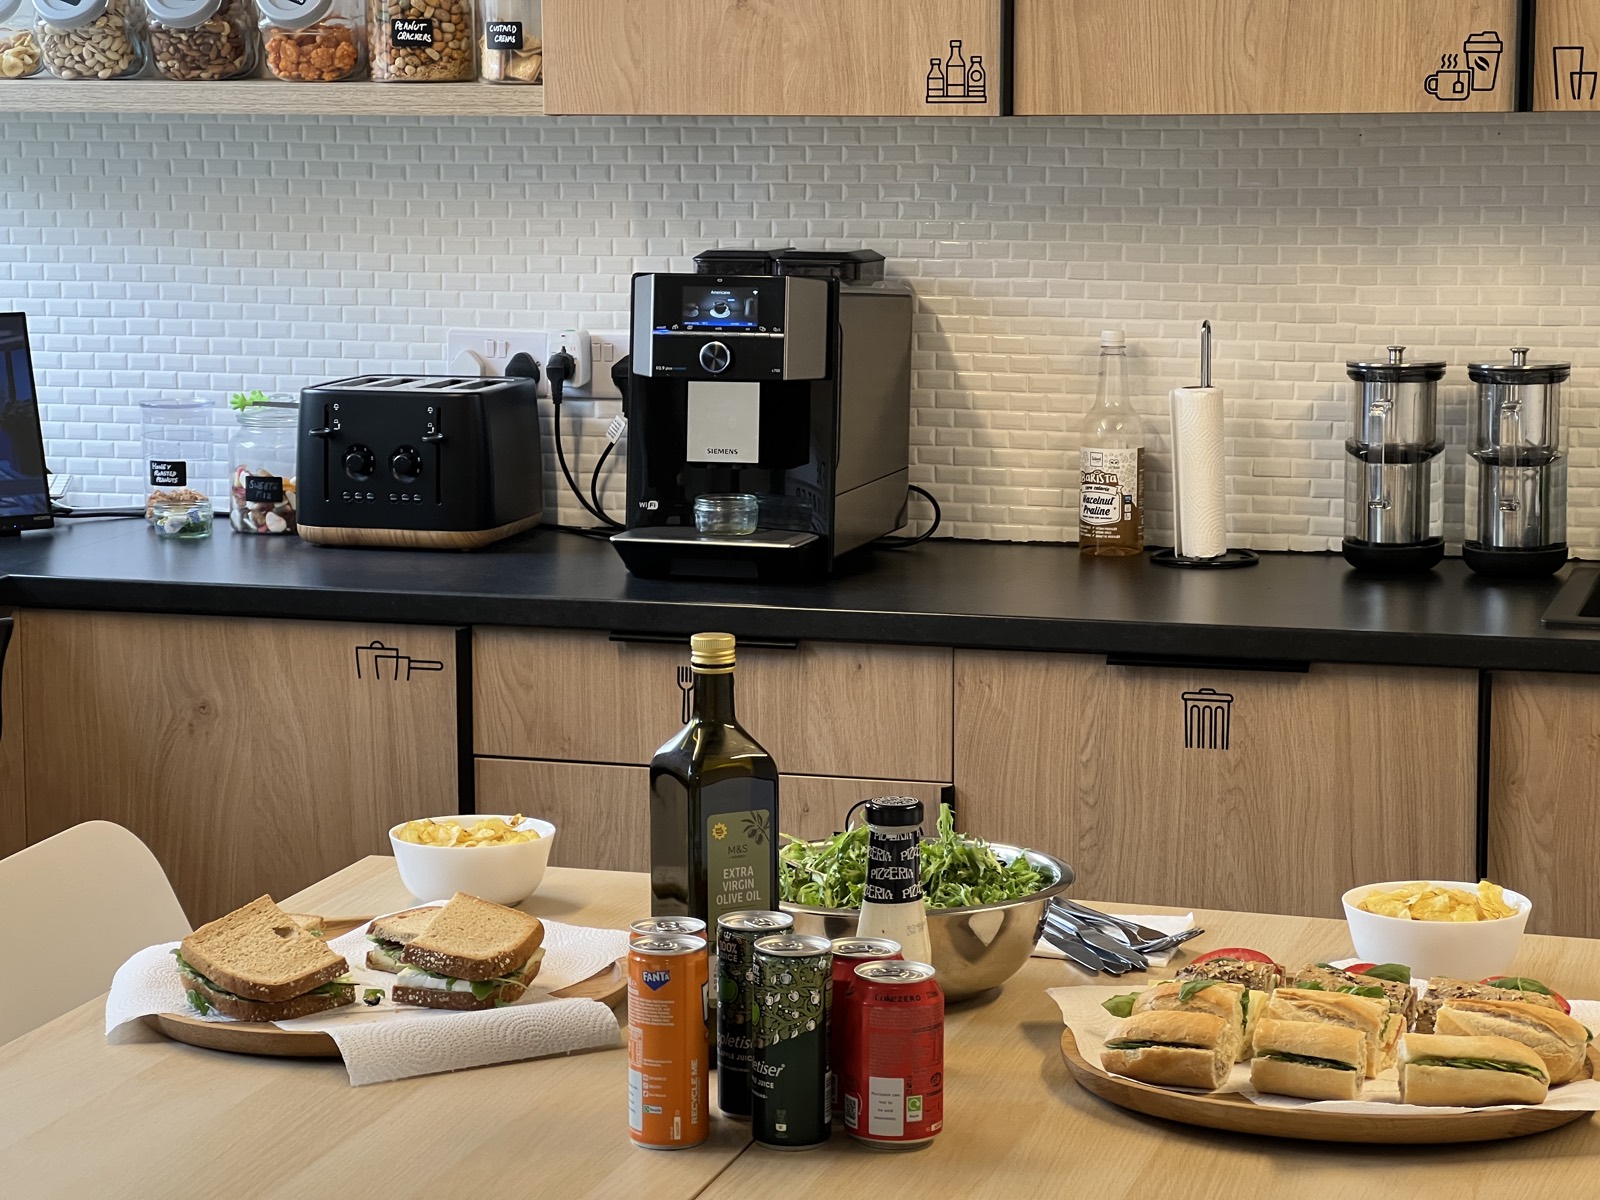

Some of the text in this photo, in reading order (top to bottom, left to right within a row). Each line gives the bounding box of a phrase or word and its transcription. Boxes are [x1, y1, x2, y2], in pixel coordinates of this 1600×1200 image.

[394, 20, 428, 31] PEANUT
[489, 24, 517, 34] CUSTARD
[396, 31, 432, 42] CRACKERS
[151, 462, 171, 470] HONEY
[1082, 494, 1115, 506] Hazelnut
[1083, 505, 1111, 516] Praline
[727, 844, 748, 855] M&S
[723, 865, 754, 879] EXTRA
[870, 866, 914, 880] PIZZERIA
[722, 878, 754, 892] VIRGIN
[716, 890, 761, 905] OLIVE OIL
[642, 971, 670, 982] FANTA
[691, 1059, 698, 1076] ME
[757, 1080, 775, 1089] JUICE
